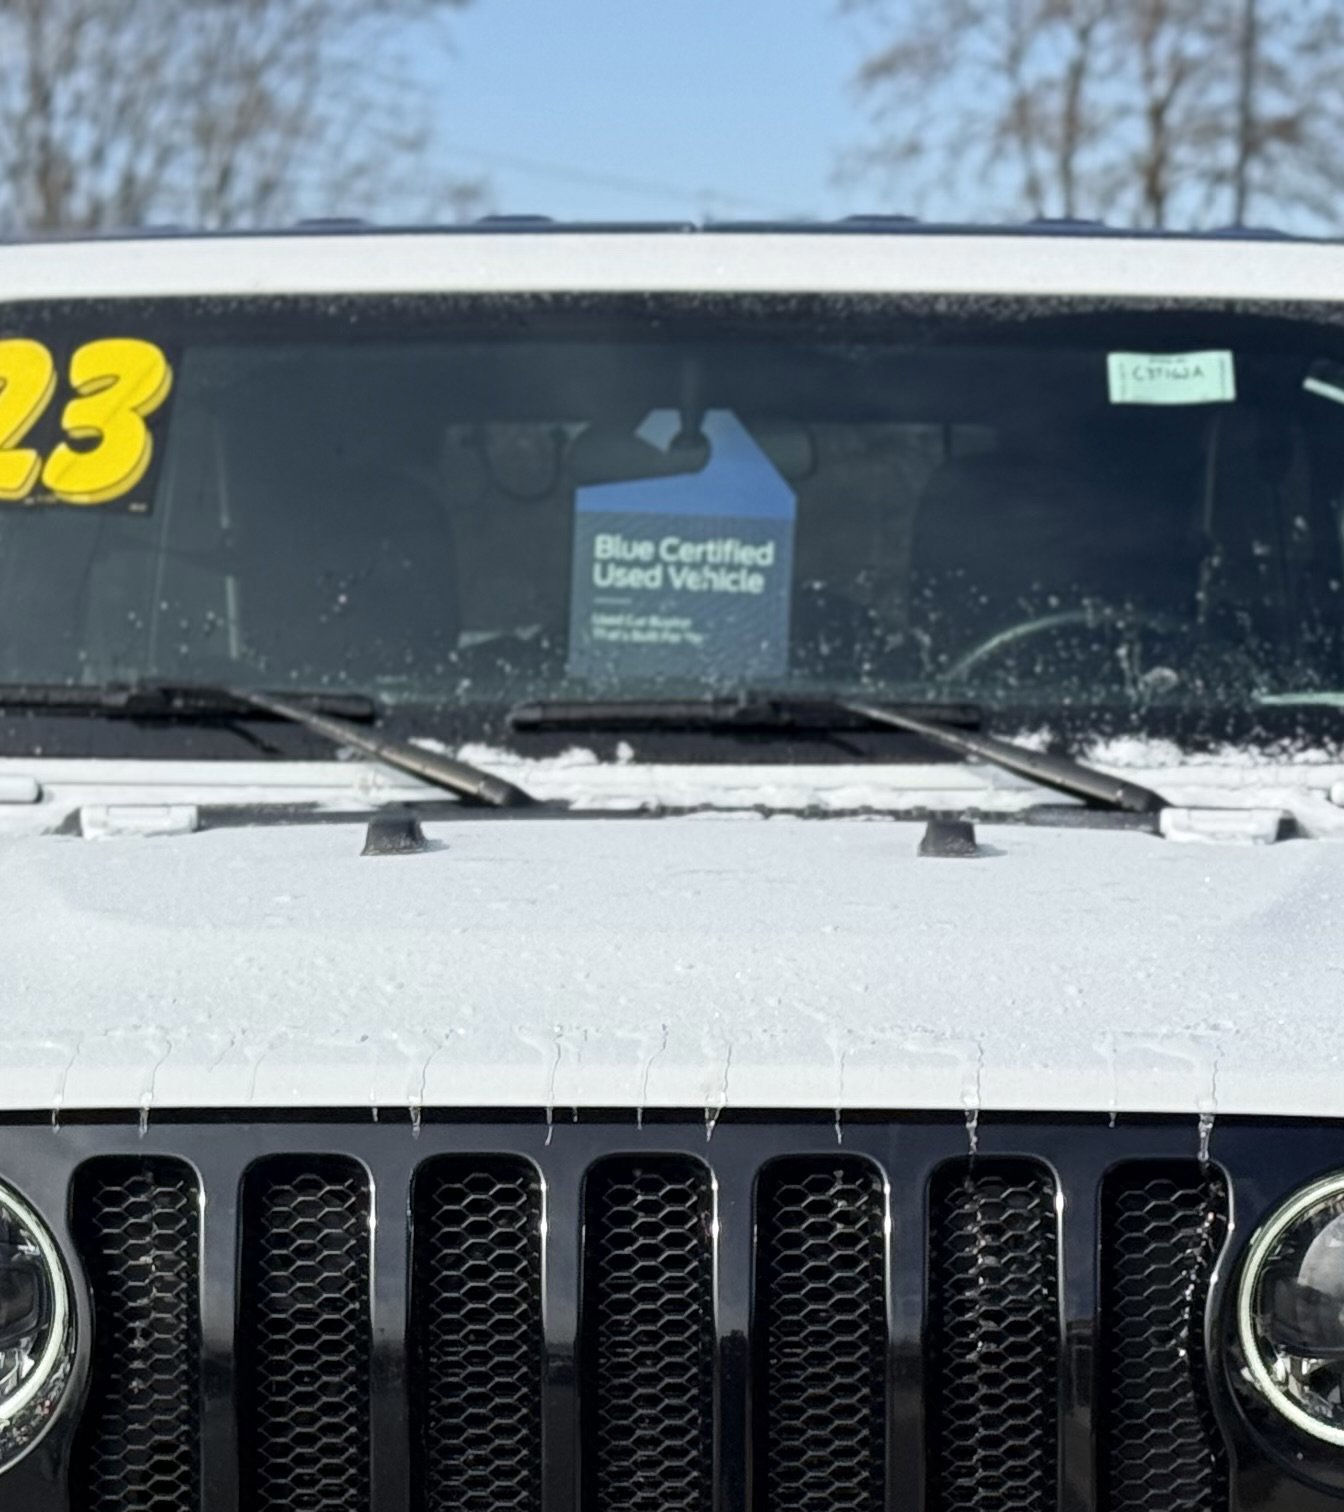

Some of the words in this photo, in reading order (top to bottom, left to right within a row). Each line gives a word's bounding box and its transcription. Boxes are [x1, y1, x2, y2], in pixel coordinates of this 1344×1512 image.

[593, 533, 655, 562] Blue
[659, 536, 776, 567] Certified
[592, 562, 662, 589] Used
[667, 564, 766, 594] Vehicle
